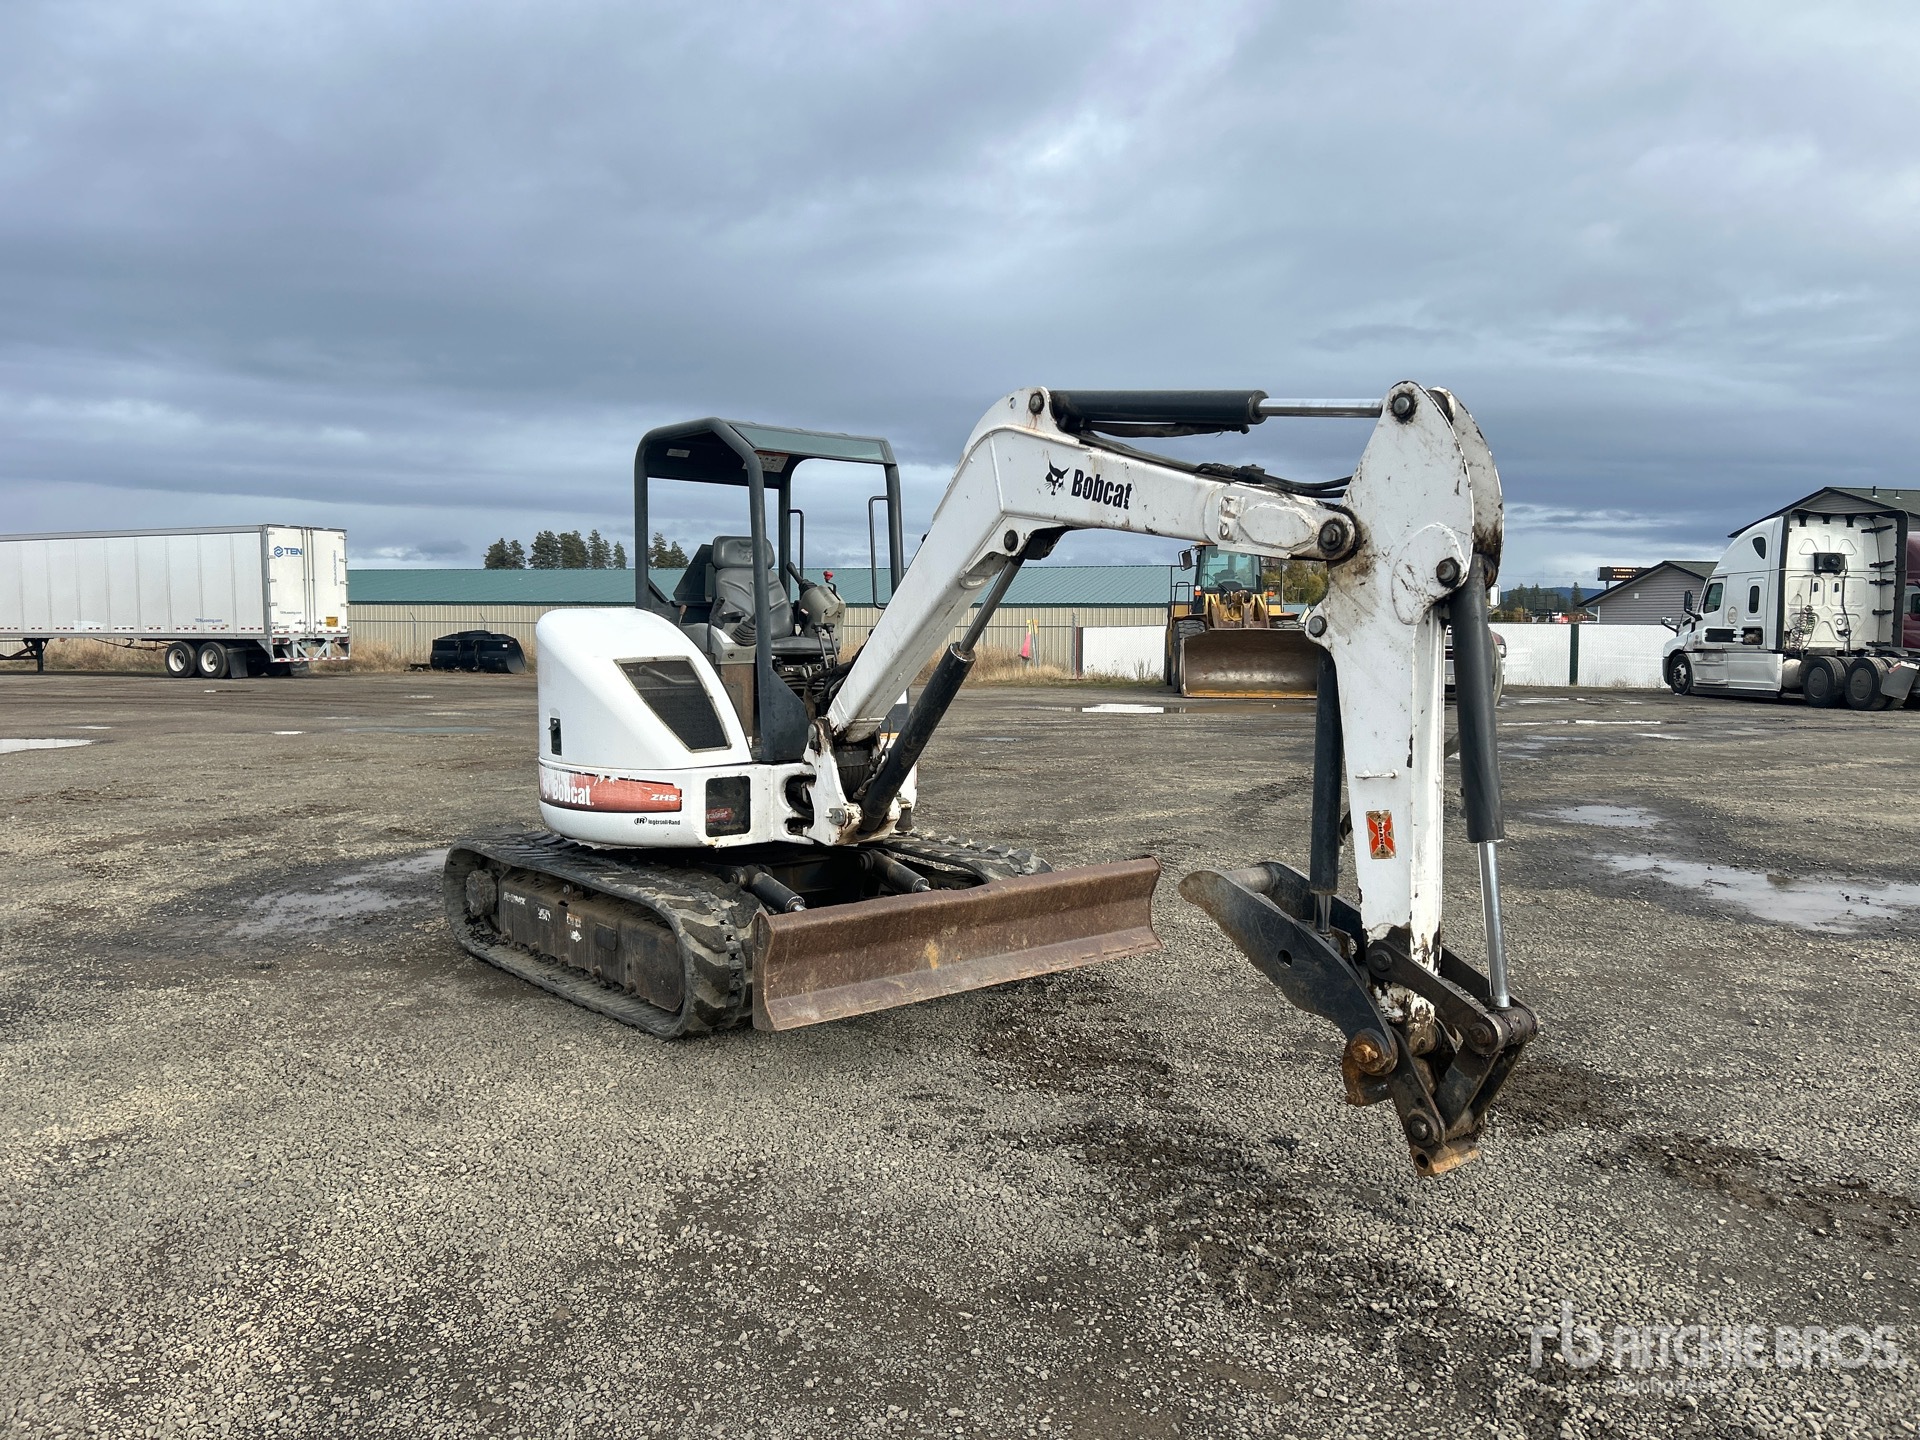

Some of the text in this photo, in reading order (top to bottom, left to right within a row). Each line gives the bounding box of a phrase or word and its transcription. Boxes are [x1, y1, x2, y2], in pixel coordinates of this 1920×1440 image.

[1071, 469, 1132, 510] Bobcat
[284, 547, 303, 555] TEN
[553, 779, 592, 806] Bobcat
